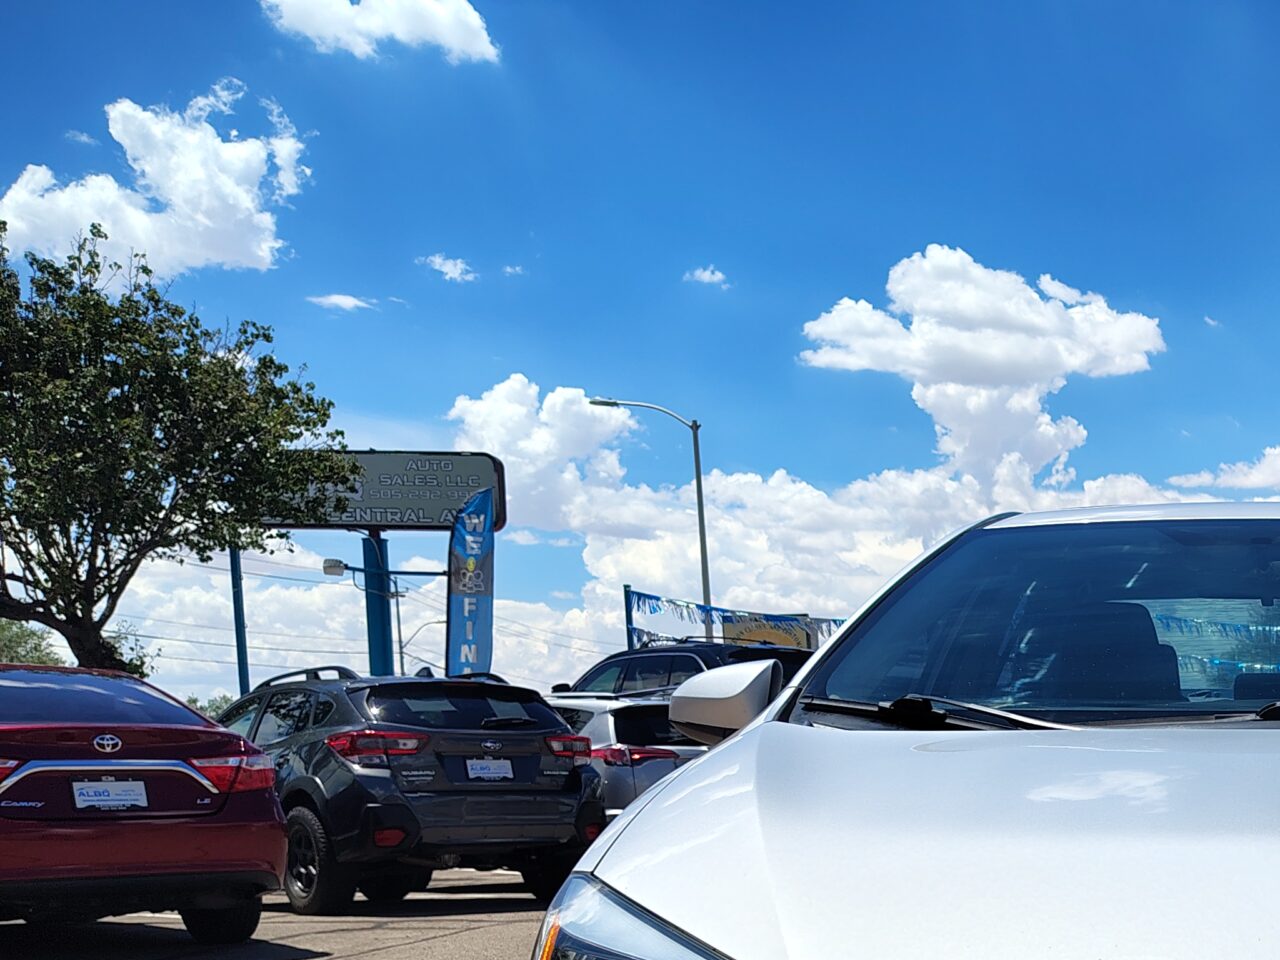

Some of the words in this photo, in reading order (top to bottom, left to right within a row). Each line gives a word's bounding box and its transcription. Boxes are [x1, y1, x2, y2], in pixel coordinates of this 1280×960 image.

[405, 460, 453, 471] AUTO
[379, 474, 442, 487] SALES,
[445, 475, 480, 487] LLC
[463, 513, 485, 555] WE
[460, 597, 477, 675] FIN
